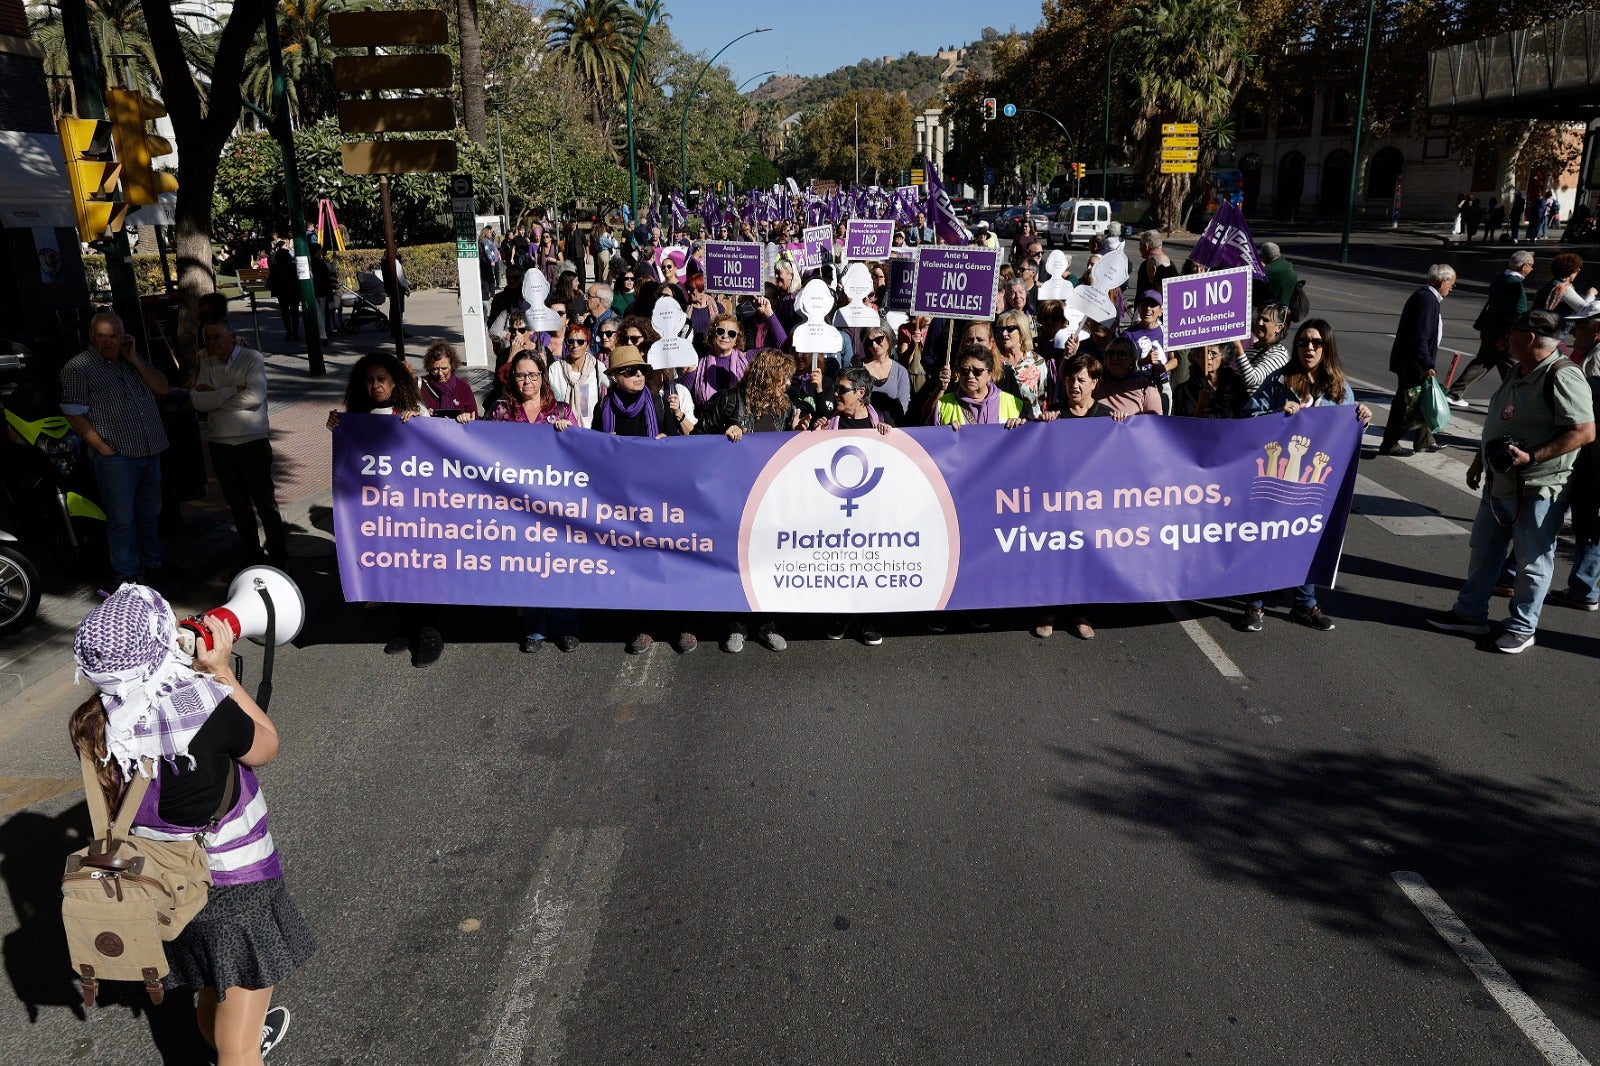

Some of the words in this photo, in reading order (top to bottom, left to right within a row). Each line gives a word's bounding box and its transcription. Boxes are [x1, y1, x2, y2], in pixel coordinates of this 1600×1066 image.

[862, 234, 877, 246] ¡NO
[853, 246, 861, 255] TE
[861, 246, 885, 256] CALLES!
[961, 252, 969, 260] la
[723, 260, 742, 275] ¡NO
[922, 260, 954, 269] Violencia
[954, 261, 964, 270] de
[964, 262, 992, 271] Género
[713, 275, 722, 287] TE
[723, 275, 755, 289] CALLES!
[941, 271, 968, 291] ¡NO
[925, 292, 938, 308] TE
[939, 293, 983, 311] CALLES!
[1183, 291, 1197, 310] DI
[1205, 279, 1232, 307] NO
[1179, 317, 1187, 326] A
[1187, 316, 1196, 326] la
[1196, 310, 1235, 324] Violencia
[1169, 328, 1197, 339] contra
[1197, 326, 1210, 336] las
[1211, 321, 1245, 334] mujeres
[361, 454, 393, 477] 25
[400, 455, 434, 478] de
[442, 458, 590, 488] Noviembre
[361, 484, 405, 508] Día
[413, 487, 588, 519] Internacional
[596, 502, 654, 525] para
[662, 502, 685, 524] la
[996, 485, 1031, 515] Ni
[1042, 489, 1103, 512] una
[1113, 483, 1232, 509] menos,
[360, 515, 517, 542] eliminación
[524, 521, 558, 543] de
[565, 524, 588, 545] la
[594, 529, 714, 553] violencia
[777, 528, 920, 550] Plataforma
[993, 524, 1085, 553] Vivas
[1095, 526, 1150, 549] nos
[1159, 513, 1323, 551] queremos
[812, 548, 858, 561] contra
[861, 549, 880, 561] las
[360, 549, 447, 570] contra
[456, 549, 492, 571] las
[500, 551, 616, 579] mujeres.
[774, 559, 845, 573] violencias
[849, 559, 922, 572] machistas
[773, 574, 869, 589] VIOLENCIA
[875, 573, 923, 589] CERO
